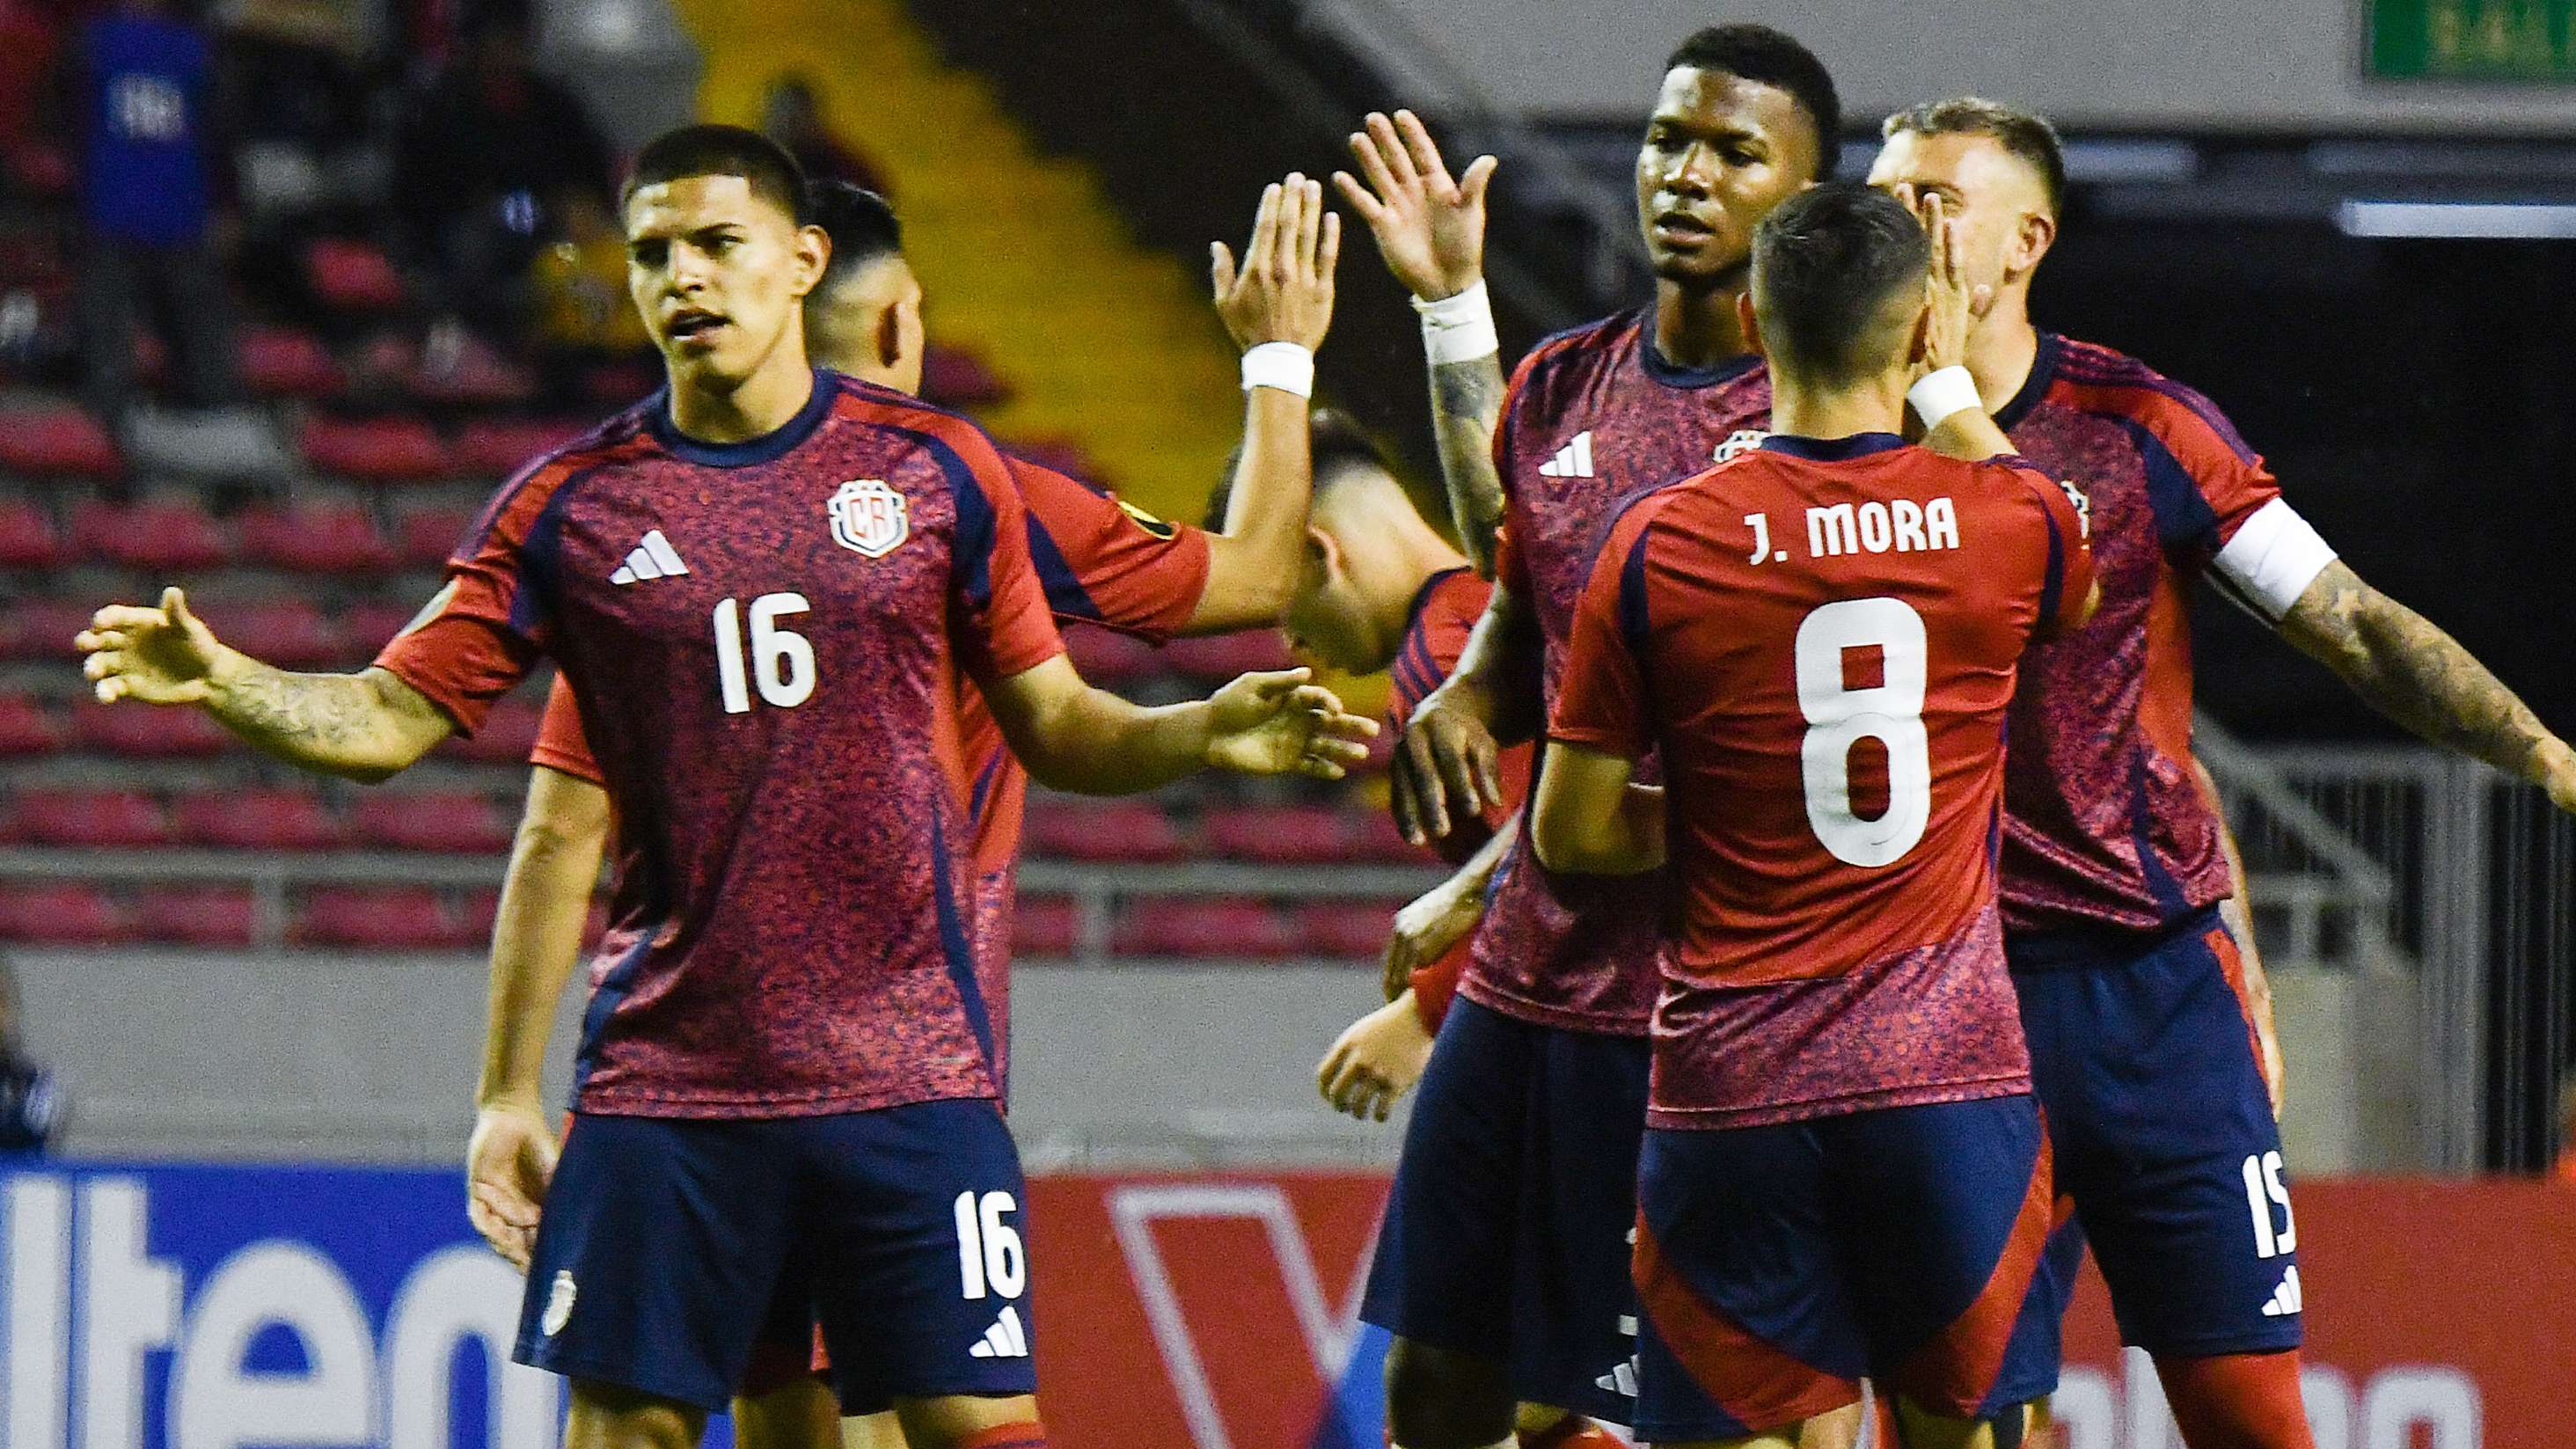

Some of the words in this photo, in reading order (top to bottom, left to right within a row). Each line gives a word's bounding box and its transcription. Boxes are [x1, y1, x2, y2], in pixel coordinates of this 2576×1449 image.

[1743, 512, 1789, 566] J.
[1805, 497, 1960, 558] MORA
[712, 591, 816, 714] 16
[1794, 596, 1932, 867] 8
[953, 1190, 1027, 1299] 16
[2241, 1150, 2297, 1259] 15
